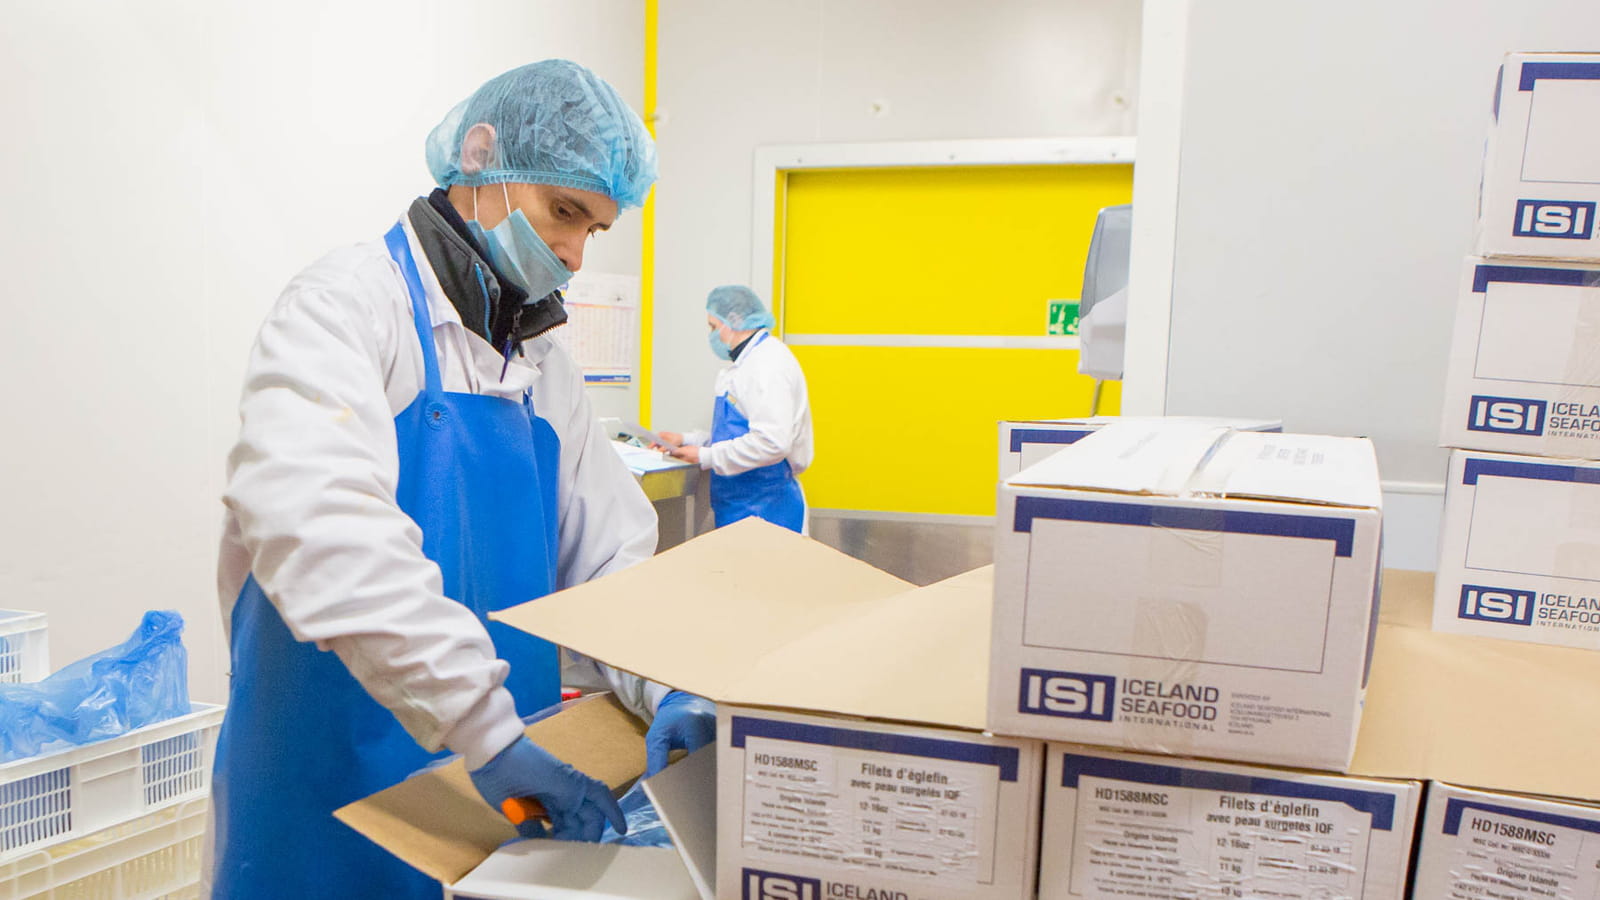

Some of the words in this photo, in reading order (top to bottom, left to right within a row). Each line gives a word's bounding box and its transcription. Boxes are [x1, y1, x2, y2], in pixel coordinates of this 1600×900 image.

[1520, 204, 1588, 235] ISI
[1475, 400, 1539, 431] ISI
[1465, 590, 1528, 621] ISI
[1027, 674, 1106, 715] ISI
[1121, 679, 1219, 703] ICELAND
[1120, 698, 1217, 721] SEAFOOD
[1119, 715, 1215, 732] INTERNATIONAL
[754, 752, 819, 772] HD1588MSC
[861, 763, 893, 779] Filets
[896, 767, 949, 785] d'églefin
[850, 779, 872, 790] avec
[874, 782, 898, 793] peau
[943, 789, 961, 801] IQF
[1094, 787, 1169, 806] HD1588MSC
[1219, 795, 1256, 812] Filets
[1260, 799, 1320, 818] d'églefin
[1206, 813, 1231, 825] avec
[1234, 816, 1261, 828] peau
[1314, 822, 1335, 835] IQF
[1470, 816, 1557, 847] HD1588MSC
